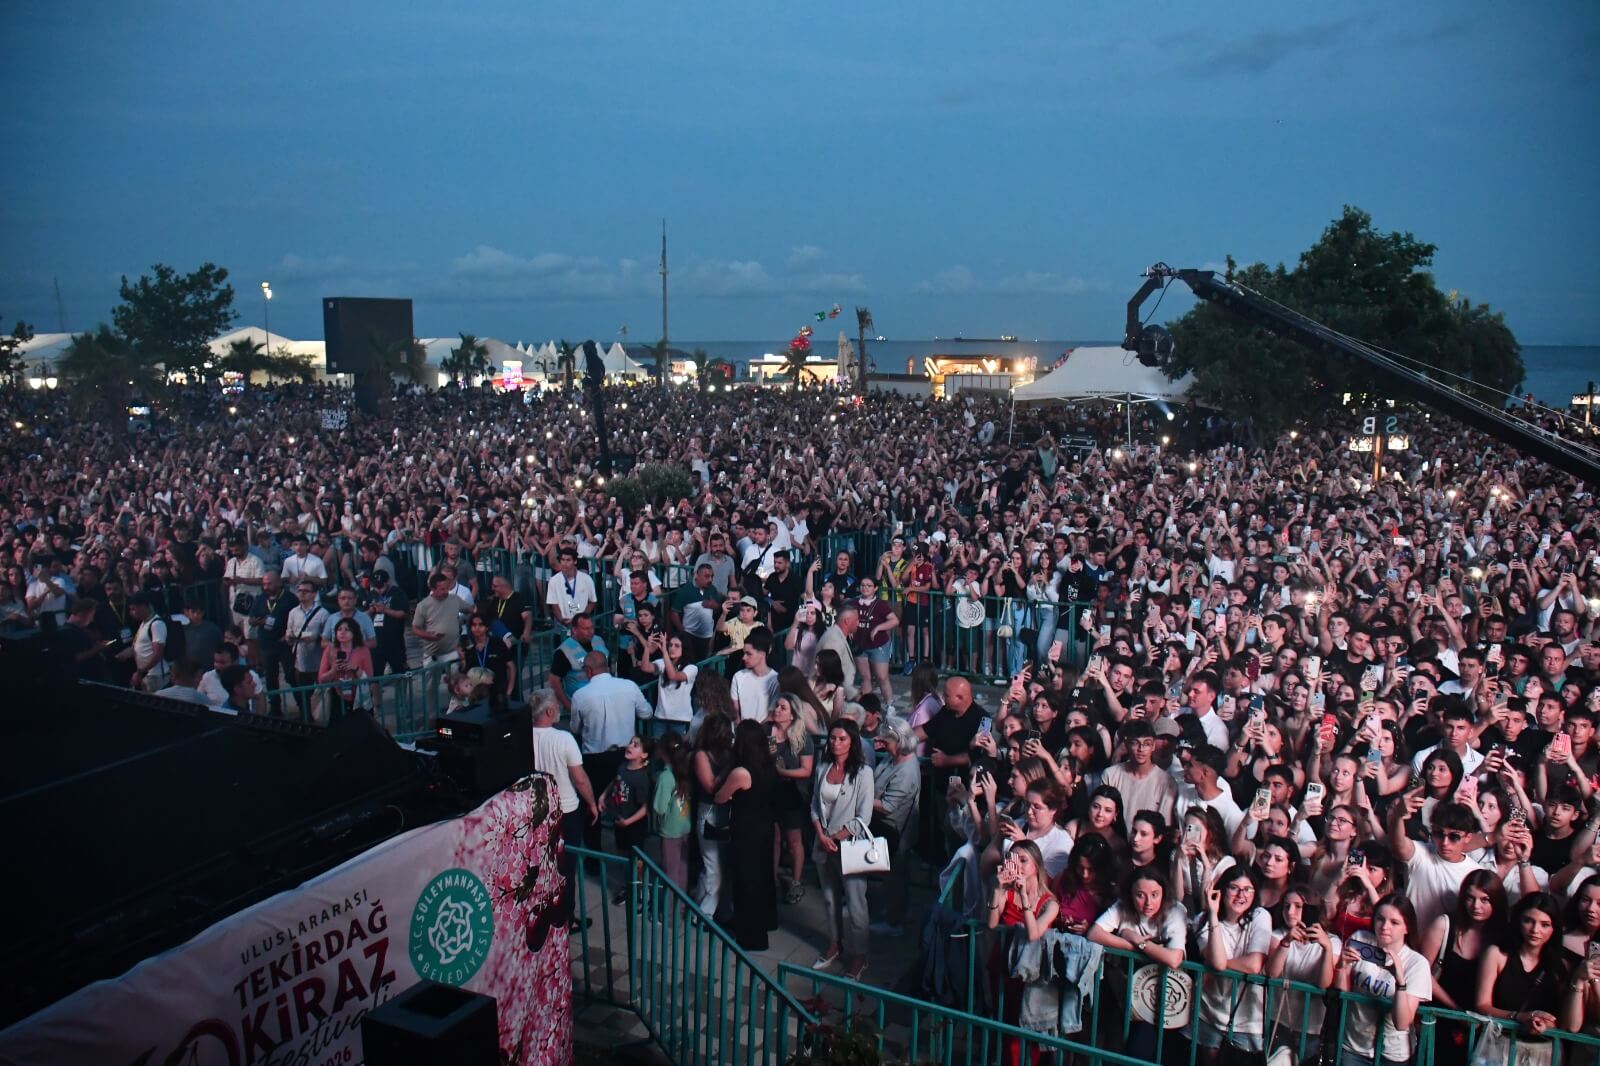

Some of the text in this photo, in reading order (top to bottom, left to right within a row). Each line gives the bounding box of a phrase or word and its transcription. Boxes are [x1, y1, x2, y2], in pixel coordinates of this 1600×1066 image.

[233, 899, 388, 1010] TEKİRDAĞ
[241, 889, 368, 965] ULUSLARARASI
[241, 937, 396, 1066] KİRAZ
[320, 1046, 352, 1066] 026
